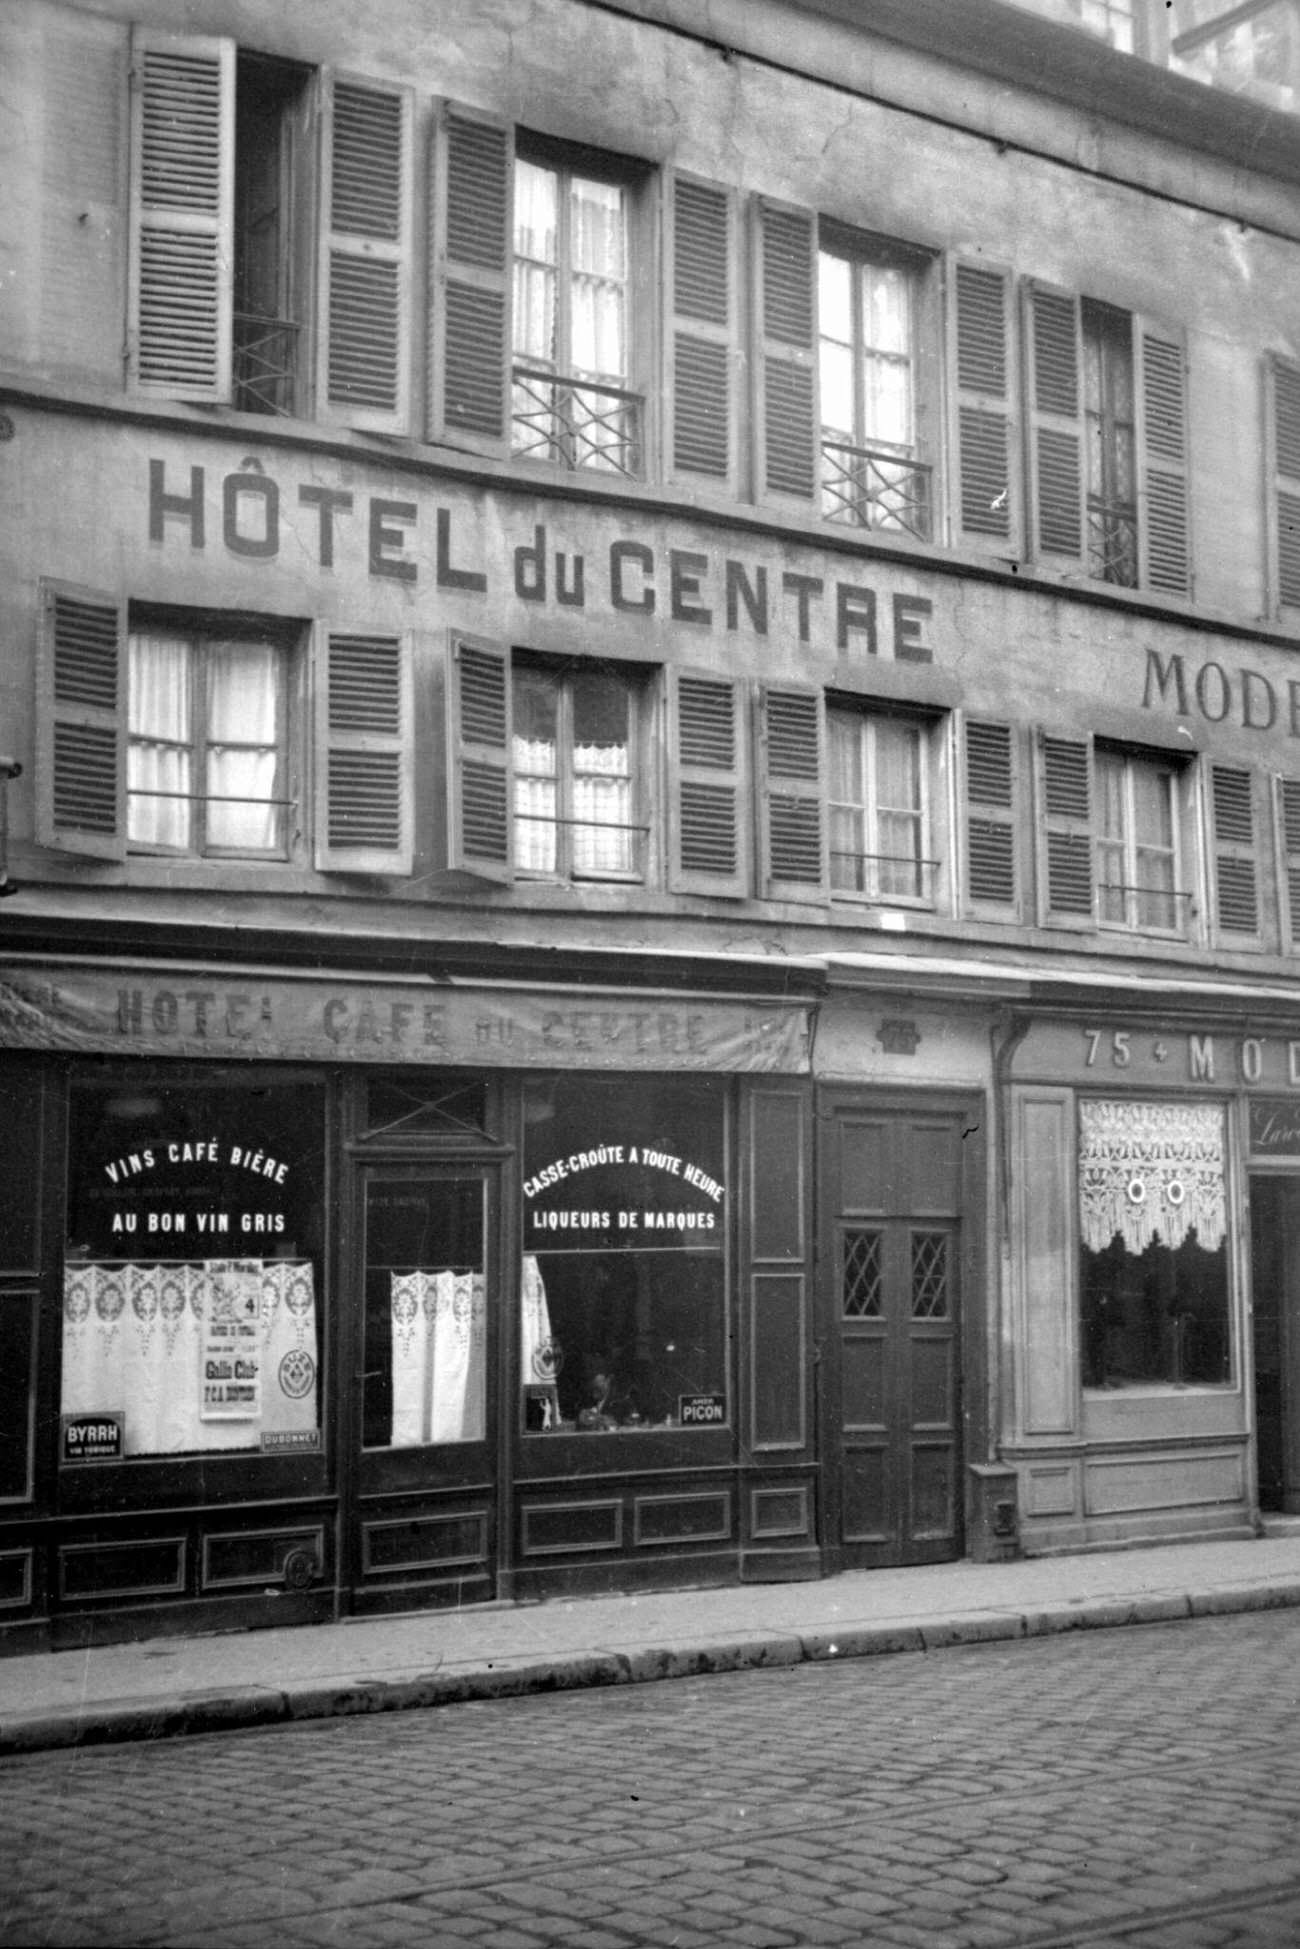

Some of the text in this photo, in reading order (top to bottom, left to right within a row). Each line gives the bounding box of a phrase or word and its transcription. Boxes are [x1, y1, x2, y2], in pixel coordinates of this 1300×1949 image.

[149, 456, 933, 663] HÔTEL du CENTRE
[1085, 1029, 1131, 1068] 75
[105, 1137, 290, 1185] VINS CAFÉ BIÈRE
[522, 1144, 726, 1203] CASSE-CROÛTE A TOUTE HEURE
[112, 1213, 286, 1233] AU BON VIN GRIS
[532, 1211, 716, 1231] LIQUEURS DE MARQUES
[683, 1405, 723, 1421] PICON
[67, 1424, 118, 1443] BYRRH
